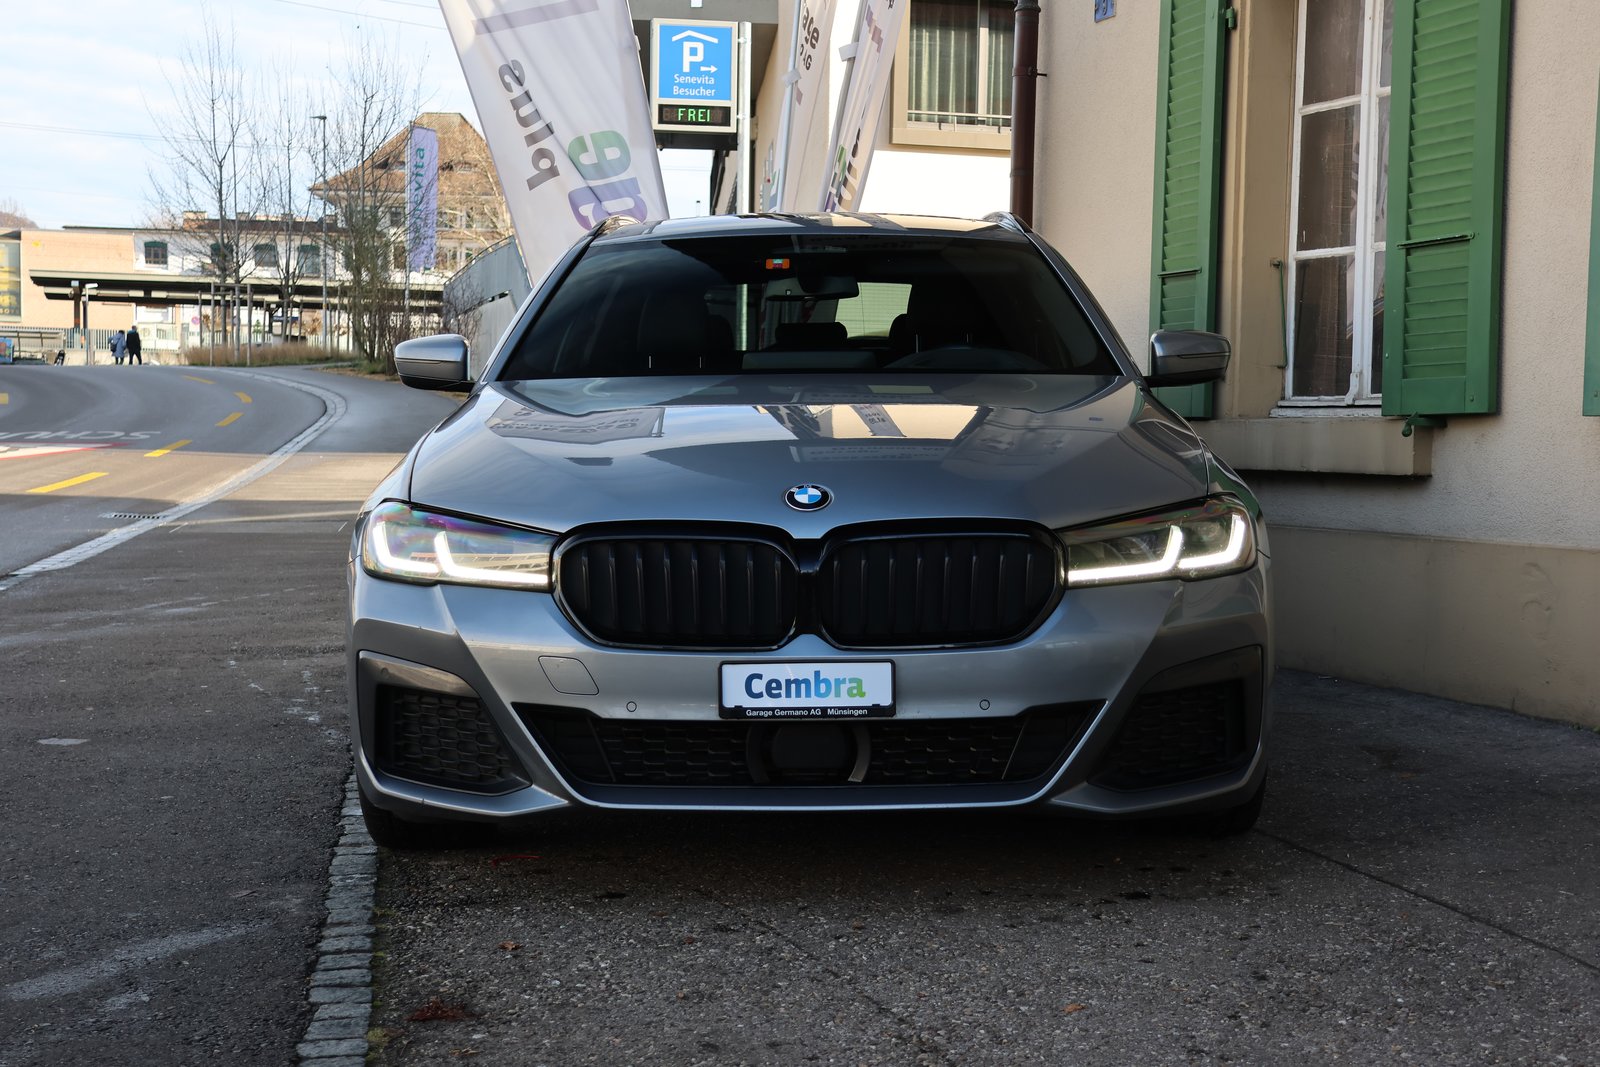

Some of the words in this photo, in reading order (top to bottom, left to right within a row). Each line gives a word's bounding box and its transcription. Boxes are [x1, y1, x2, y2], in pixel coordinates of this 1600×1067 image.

[682, 41, 704, 73] P
[673, 73, 715, 85] Senevita
[673, 85, 716, 97] Besucher
[678, 108, 711, 122] FREI
[744, 670, 867, 699] Cembra
[745, 709, 774, 718] Garage
[774, 709, 808, 717] Germano
[809, 708, 822, 716] AG
[827, 708, 868, 718] Münsingen
